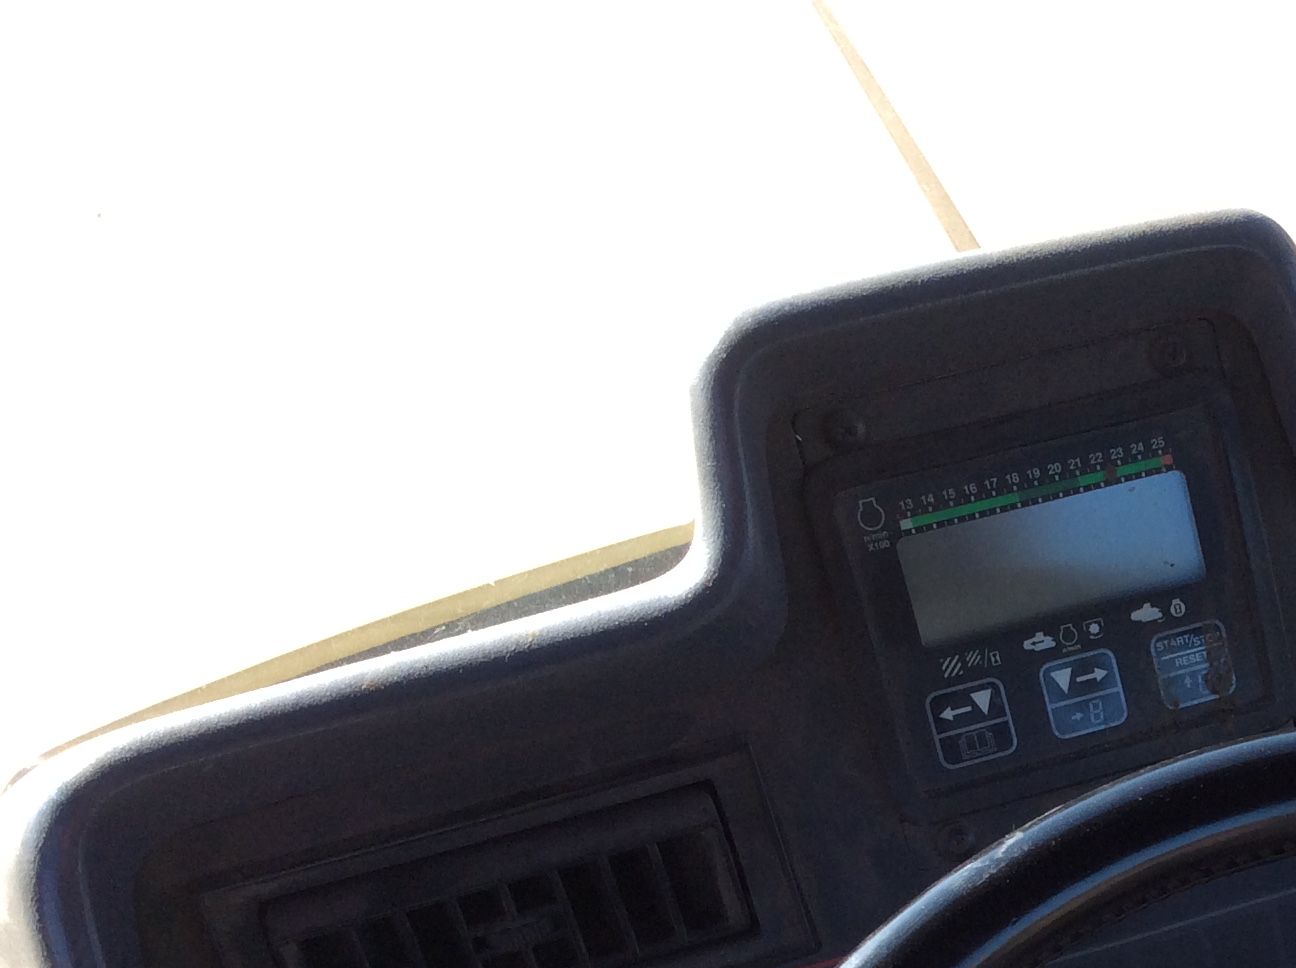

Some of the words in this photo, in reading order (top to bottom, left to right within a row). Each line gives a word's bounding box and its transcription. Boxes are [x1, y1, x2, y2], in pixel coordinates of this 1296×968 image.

[899, 499, 914, 511] 13
[921, 493, 935, 505] 14
[942, 488, 956, 500] 15
[963, 483, 978, 495] 16
[984, 478, 998, 490] 17
[1005, 473, 1020, 485] 18
[1026, 468, 1041, 479] 19
[1047, 462, 1062, 475] 20
[1068, 457, 1082, 470] 21
[1089, 452, 1104, 465] 22
[1109, 447, 1124, 460] 23
[1130, 442, 1144, 455] 24
[1151, 436, 1165, 449] 25
[1155, 631, 1221, 651] START/ST
